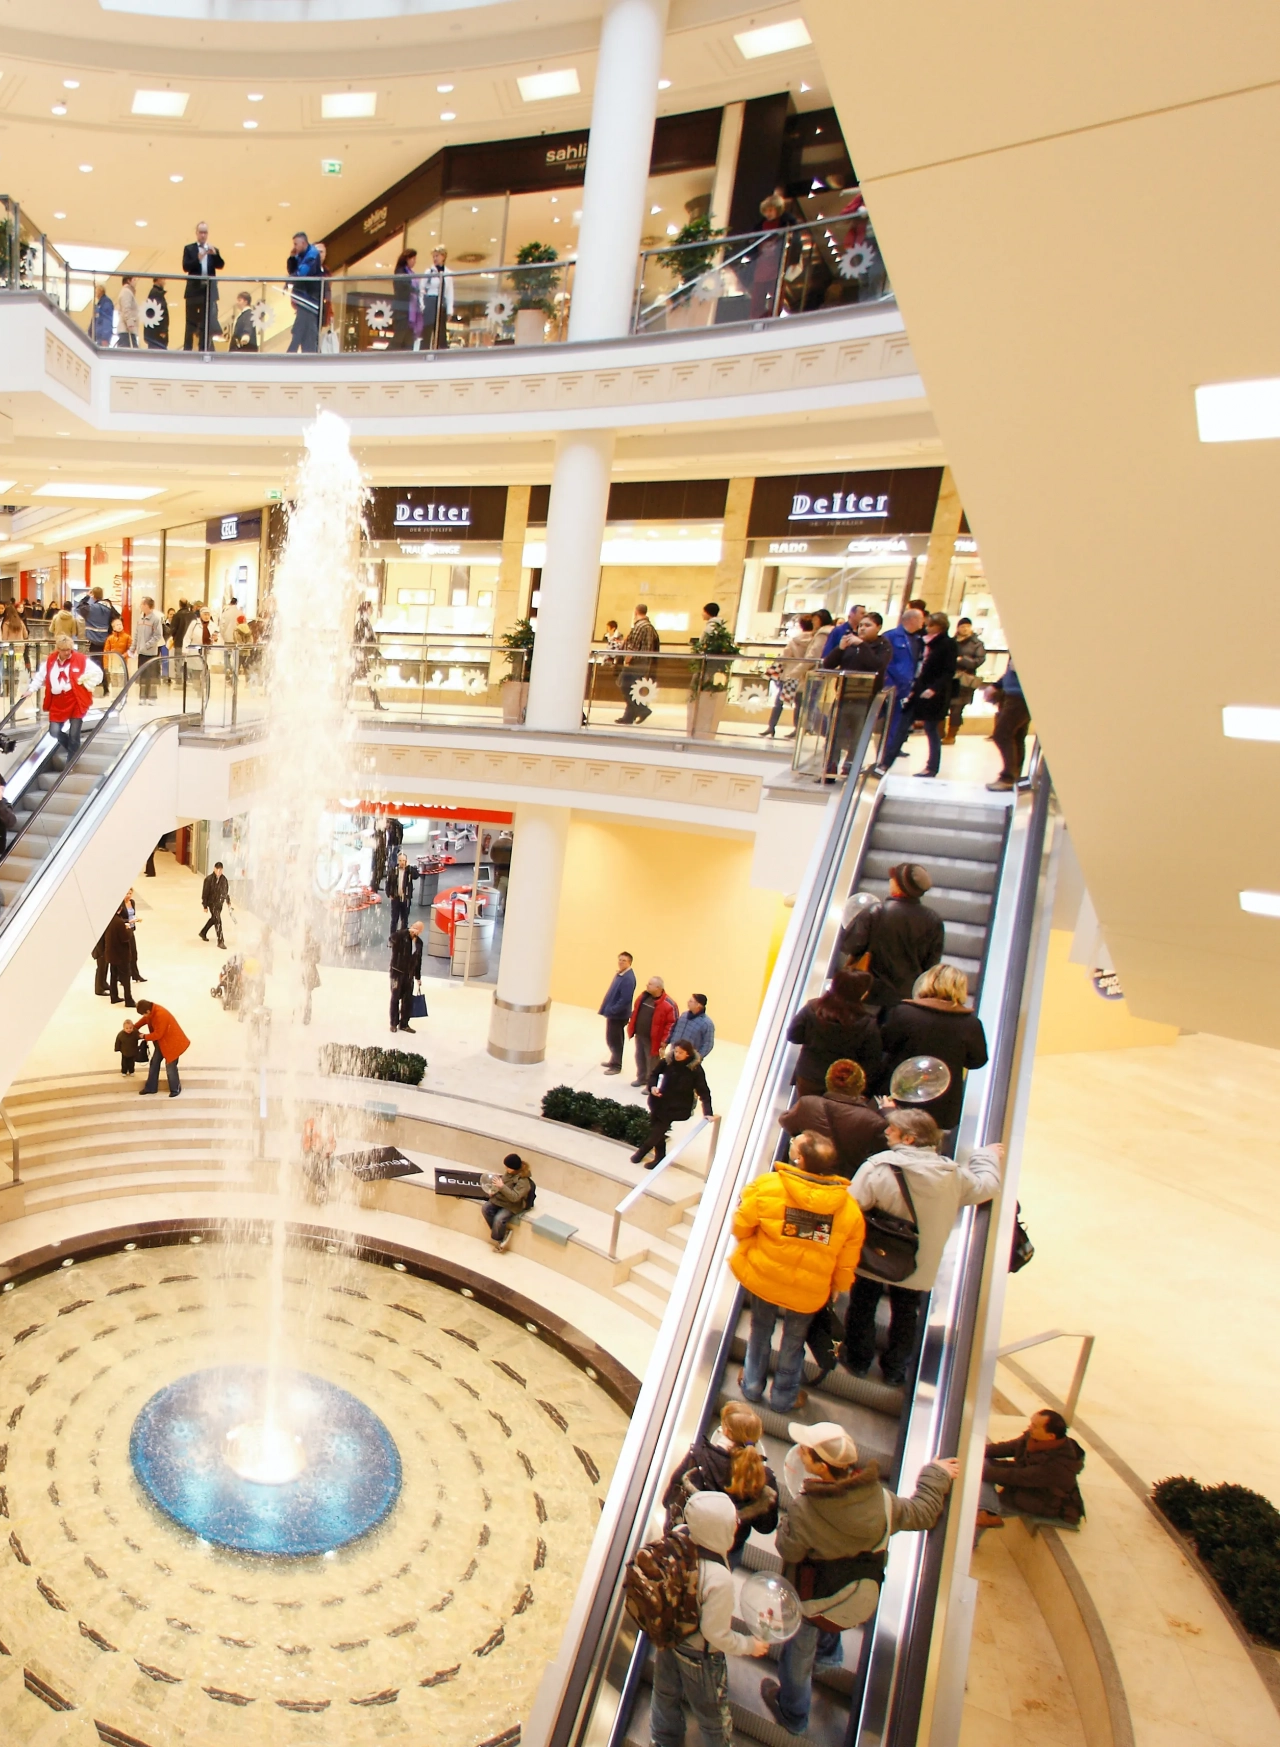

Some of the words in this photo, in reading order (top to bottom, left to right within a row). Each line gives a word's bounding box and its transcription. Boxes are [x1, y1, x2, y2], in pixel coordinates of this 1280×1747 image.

[792, 493, 888, 514] Deiter
[396, 504, 470, 521] Deiter
[221, 522, 237, 537] CECIL
[769, 543, 808, 553] RADO
